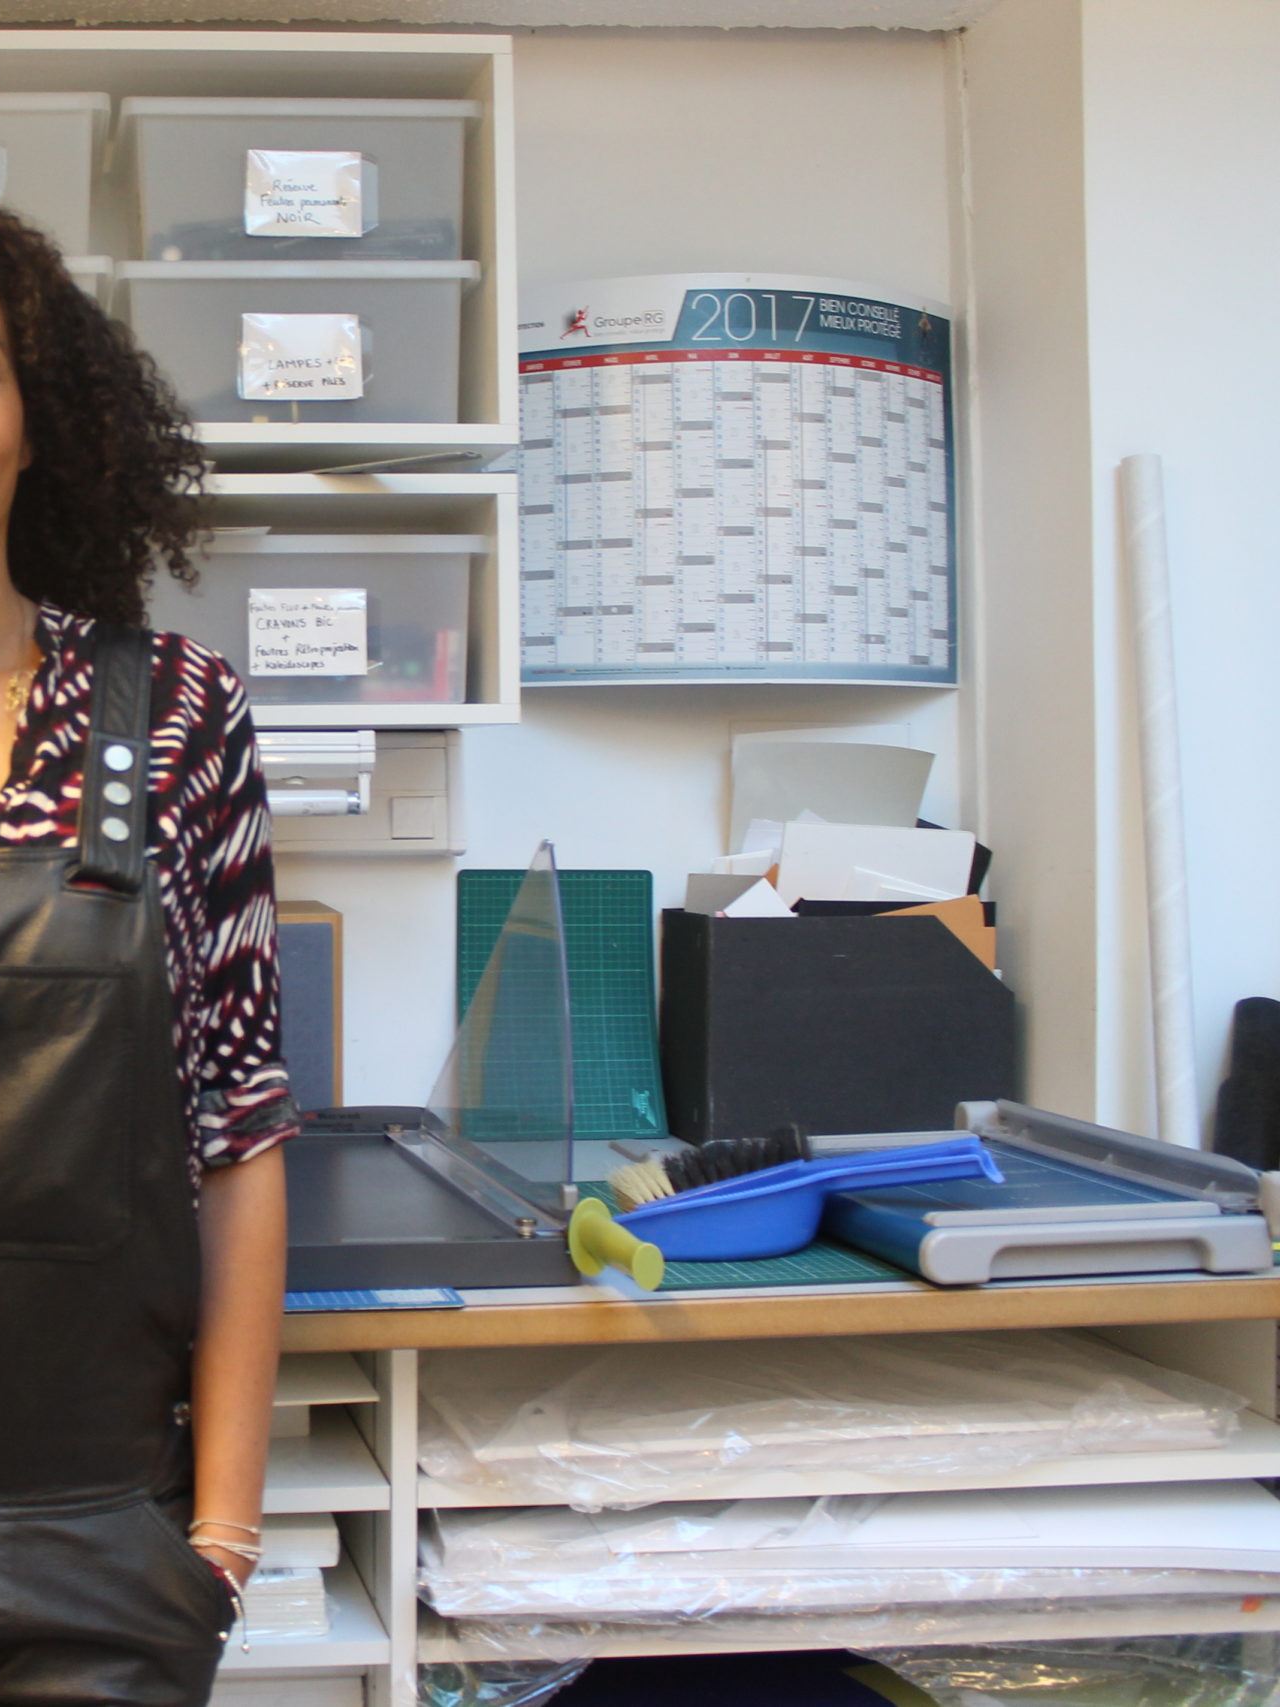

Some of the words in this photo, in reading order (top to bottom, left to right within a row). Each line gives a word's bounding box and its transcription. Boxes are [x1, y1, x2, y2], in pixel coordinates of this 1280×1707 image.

[820, 298, 845, 314] BIEN
[593, 314, 642, 329] Groupe
[644, 312, 664, 325] RG
[691, 293, 816, 342] 2017
[820, 313, 856, 332] MIEUX
[268, 359, 322, 370] LAMPES
